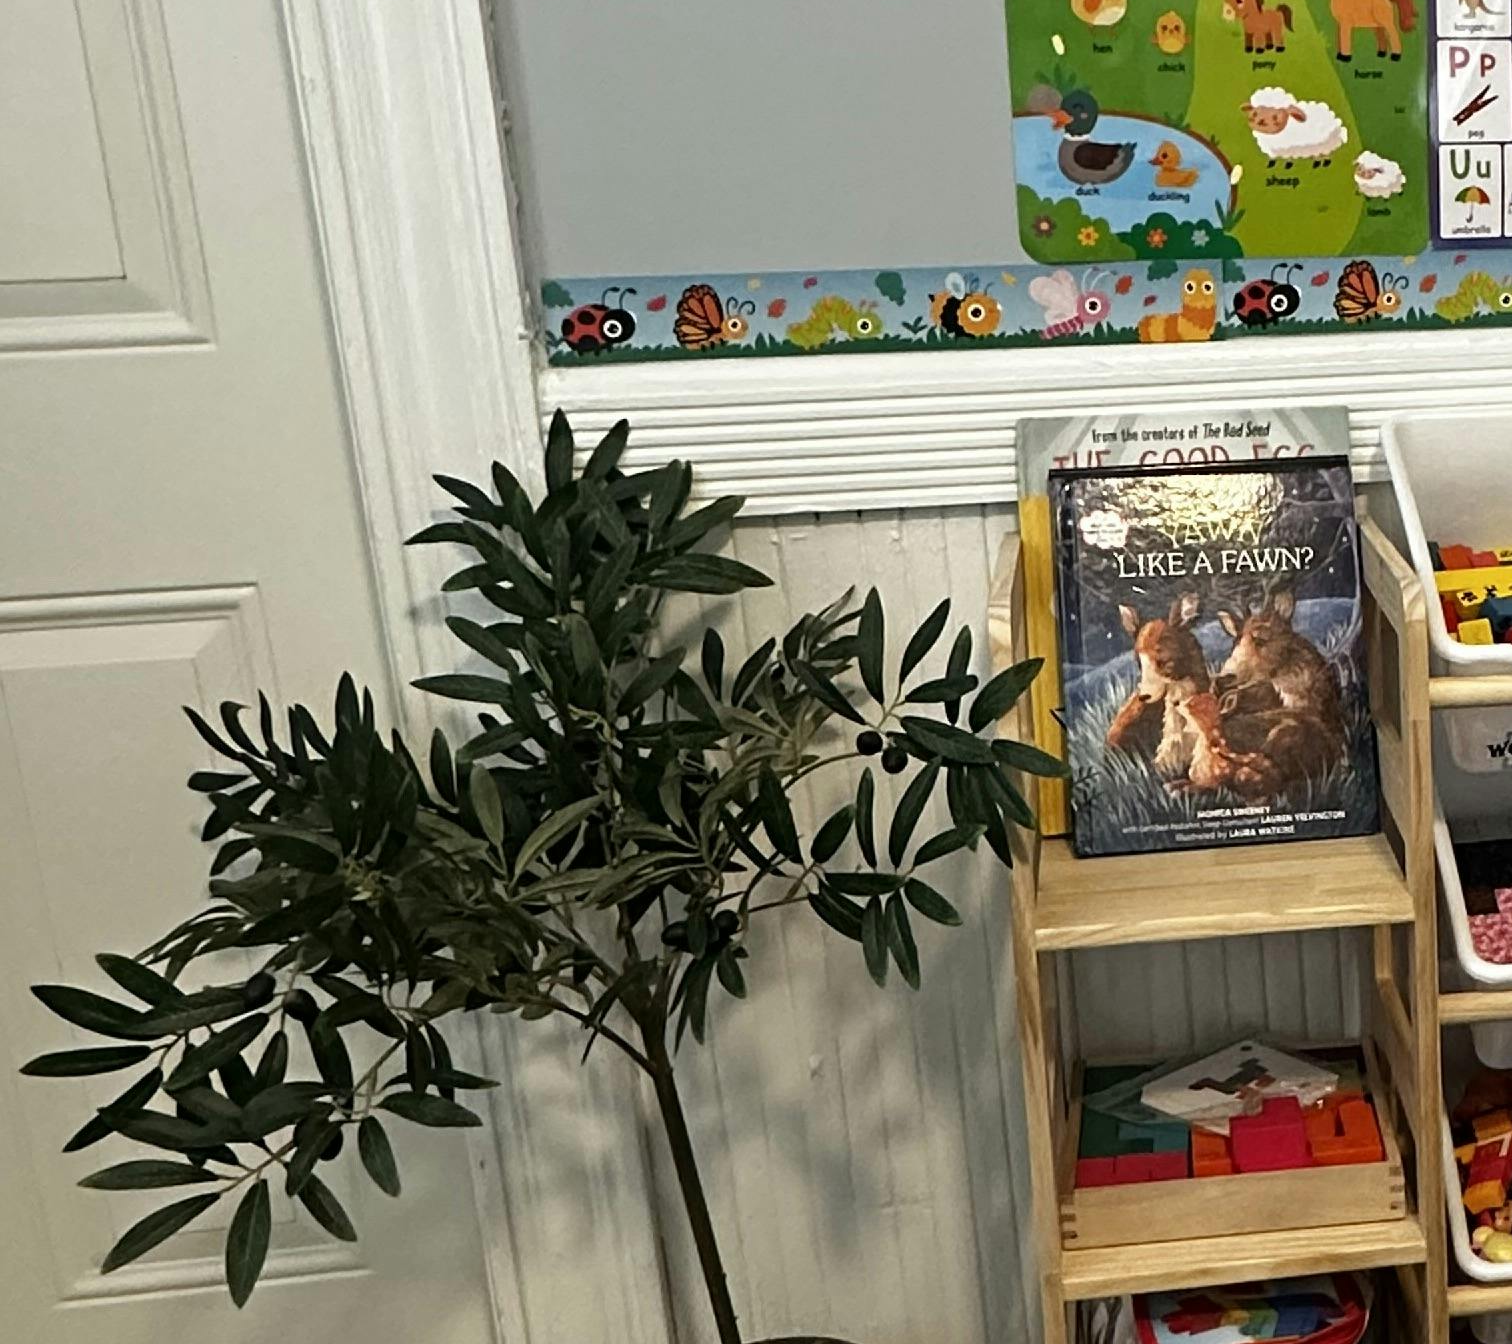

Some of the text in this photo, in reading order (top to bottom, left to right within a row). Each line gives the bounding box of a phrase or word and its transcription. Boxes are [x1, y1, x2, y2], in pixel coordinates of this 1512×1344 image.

[1093, 44, 1113, 53] hen
[1157, 62, 1185, 73] chick
[1252, 59, 1276, 72] pony
[1449, 46, 1496, 78] Pp
[1354, 68, 1384, 79] horse
[1450, 149, 1491, 180] Uu
[1265, 174, 1300, 188] sheep
[1075, 185, 1100, 197] duck
[1148, 191, 1191, 204] duckling
[1121, 429, 1138, 441] the
[1142, 426, 1184, 441] creators
[1189, 425, 1198, 439] of
[1202, 422, 1221, 438] The
[1223, 422, 1242, 437] Bad
[1246, 421, 1271, 437] Seed
[1115, 547, 1314, 578] LIKE A FAWN?
